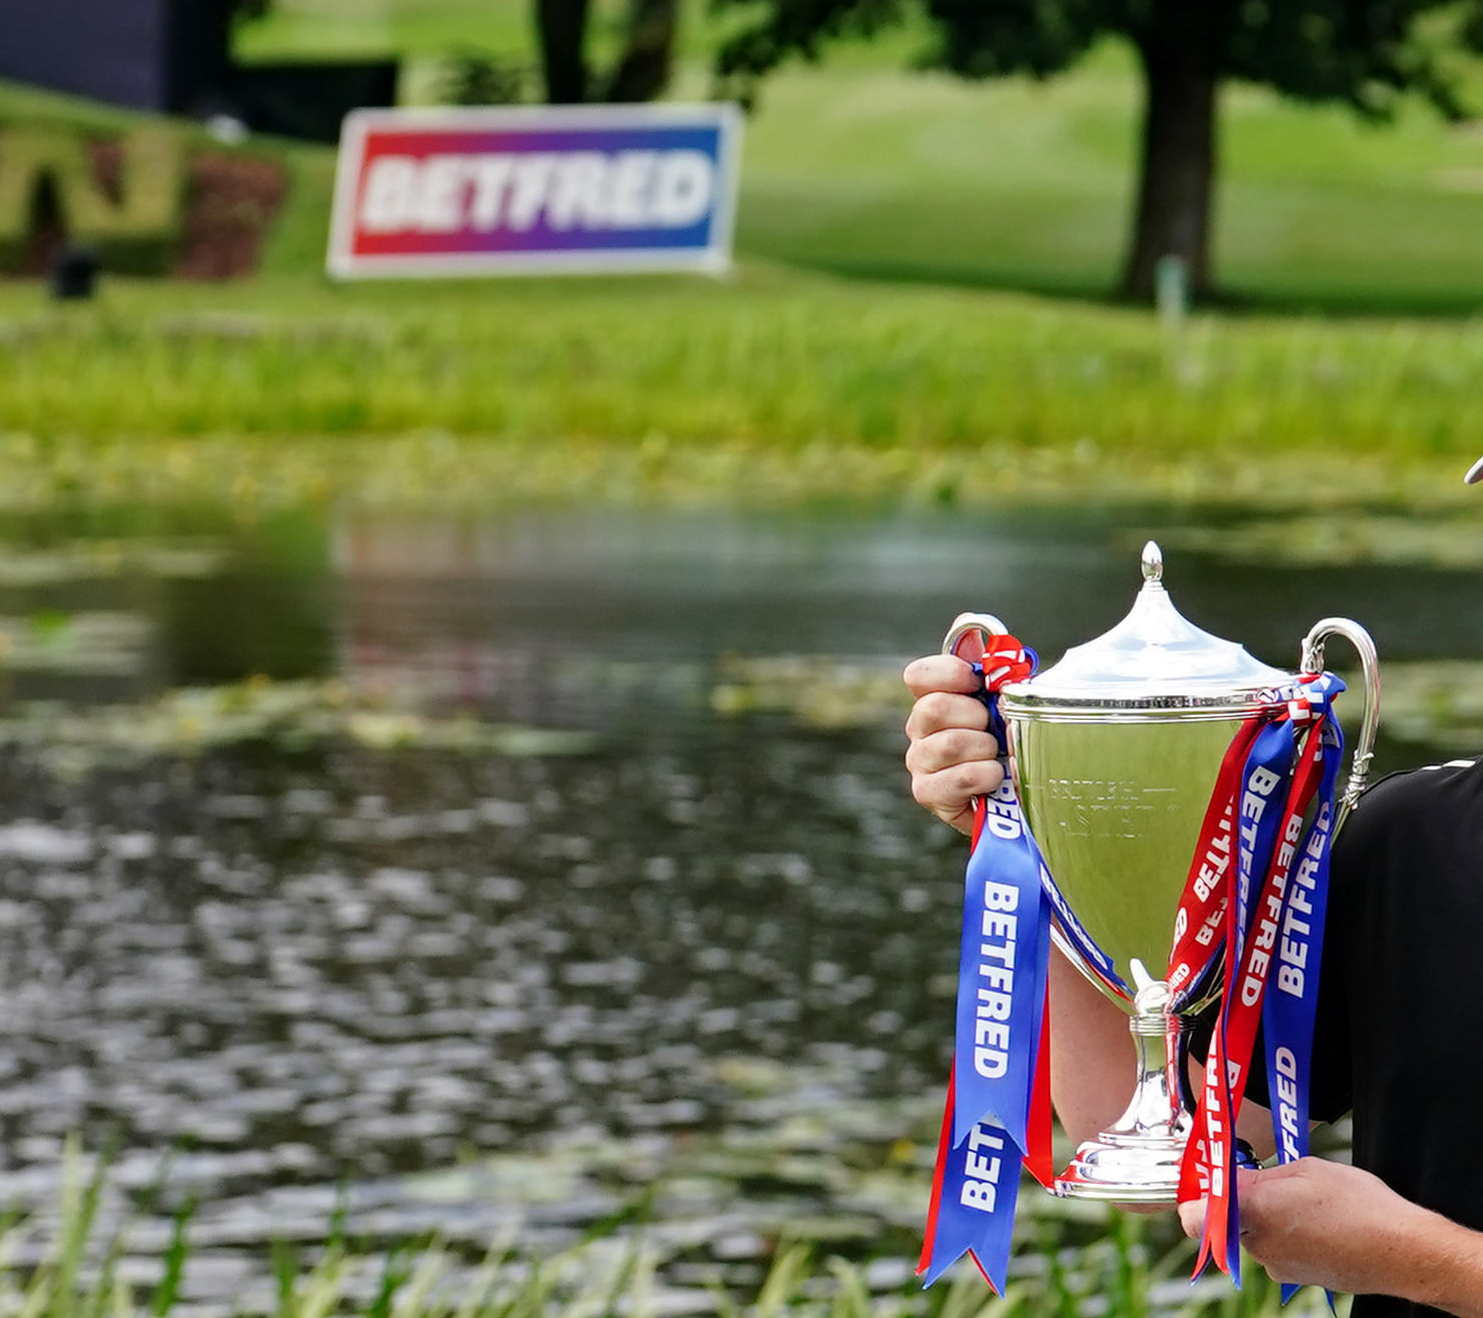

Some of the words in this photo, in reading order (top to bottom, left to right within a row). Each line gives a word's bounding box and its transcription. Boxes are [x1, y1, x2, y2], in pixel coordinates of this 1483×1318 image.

[361, 149, 713, 234] BETFRED
[1236, 765, 1281, 963] BETFRED
[1241, 814, 1304, 1007] BETFRED
[1278, 801, 1330, 999] BETFRED
[974, 880, 1020, 1080] BETFRED
